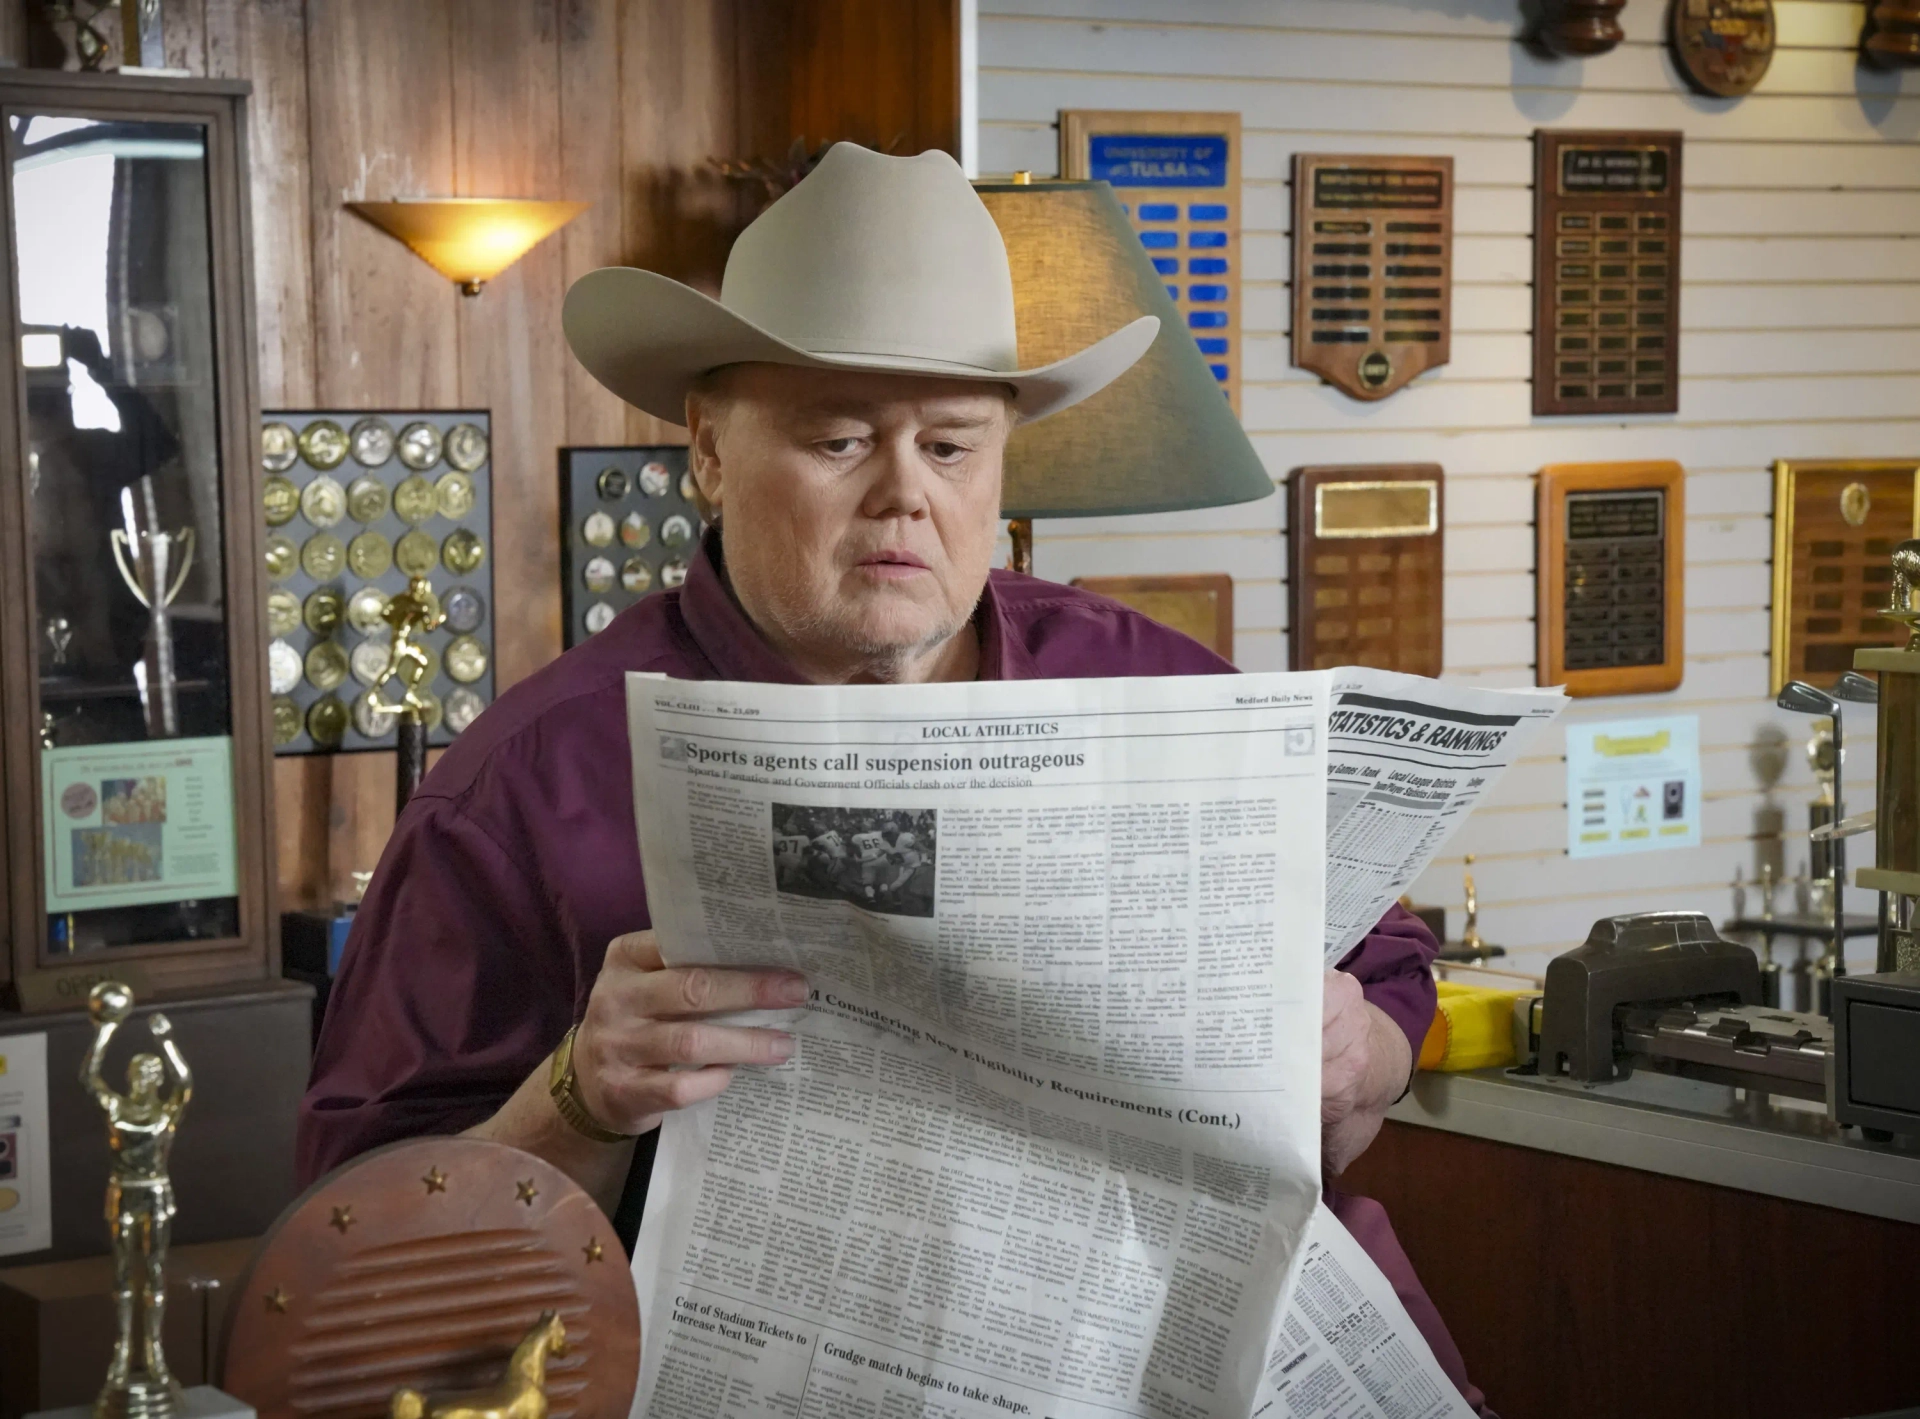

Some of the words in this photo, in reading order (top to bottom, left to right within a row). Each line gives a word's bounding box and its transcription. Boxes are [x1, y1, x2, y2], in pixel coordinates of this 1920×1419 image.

[1130, 162, 1188, 176] TULSA
[922, 726, 971, 738] LOCAL
[976, 722, 1059, 737] ATHLETICS
[1410, 723, 1430, 742] &
[1425, 725, 1508, 750] RANKINGS
[686, 742, 748, 764] Sports
[754, 753, 817, 772] agents
[824, 753, 858, 771] call
[865, 752, 972, 775] suspension
[980, 752, 1084, 772] outrageous
[687, 764, 720, 778] Sports
[773, 777, 791, 786] and
[795, 777, 860, 790] Government
[864, 777, 910, 789] Officials
[913, 778, 940, 789] clash
[943, 781, 967, 789] over
[970, 778, 986, 789] the
[989, 777, 1032, 788] decision
[1361, 766, 1381, 778] Rank
[1388, 770, 1409, 782] Local
[1408, 772, 1432, 788] League
[779, 840, 798, 853] 37
[837, 1010, 850, 1019] are
[825, 993, 921, 1040] Considering
[924, 1032, 958, 1054] New
[963, 1049, 1045, 1088] Eligibility
[1050, 1080, 1173, 1119] Requirements
[671, 1310, 716, 1332] Increase
[717, 1323, 742, 1341] Next
[744, 1331, 768, 1348] Year
[675, 1295, 698, 1312] Cost
[700, 1302, 712, 1316] of
[713, 1306, 755, 1329] Stadium
[756, 1320, 794, 1341] Tickets
[796, 1333, 807, 1345] to
[824, 1342, 866, 1365] Grudge
[868, 1358, 903, 1377] match
[906, 1365, 944, 1390] begins
[947, 1381, 960, 1394] to
[962, 1384, 990, 1404] take
[992, 1395, 1031, 1416] shape.
